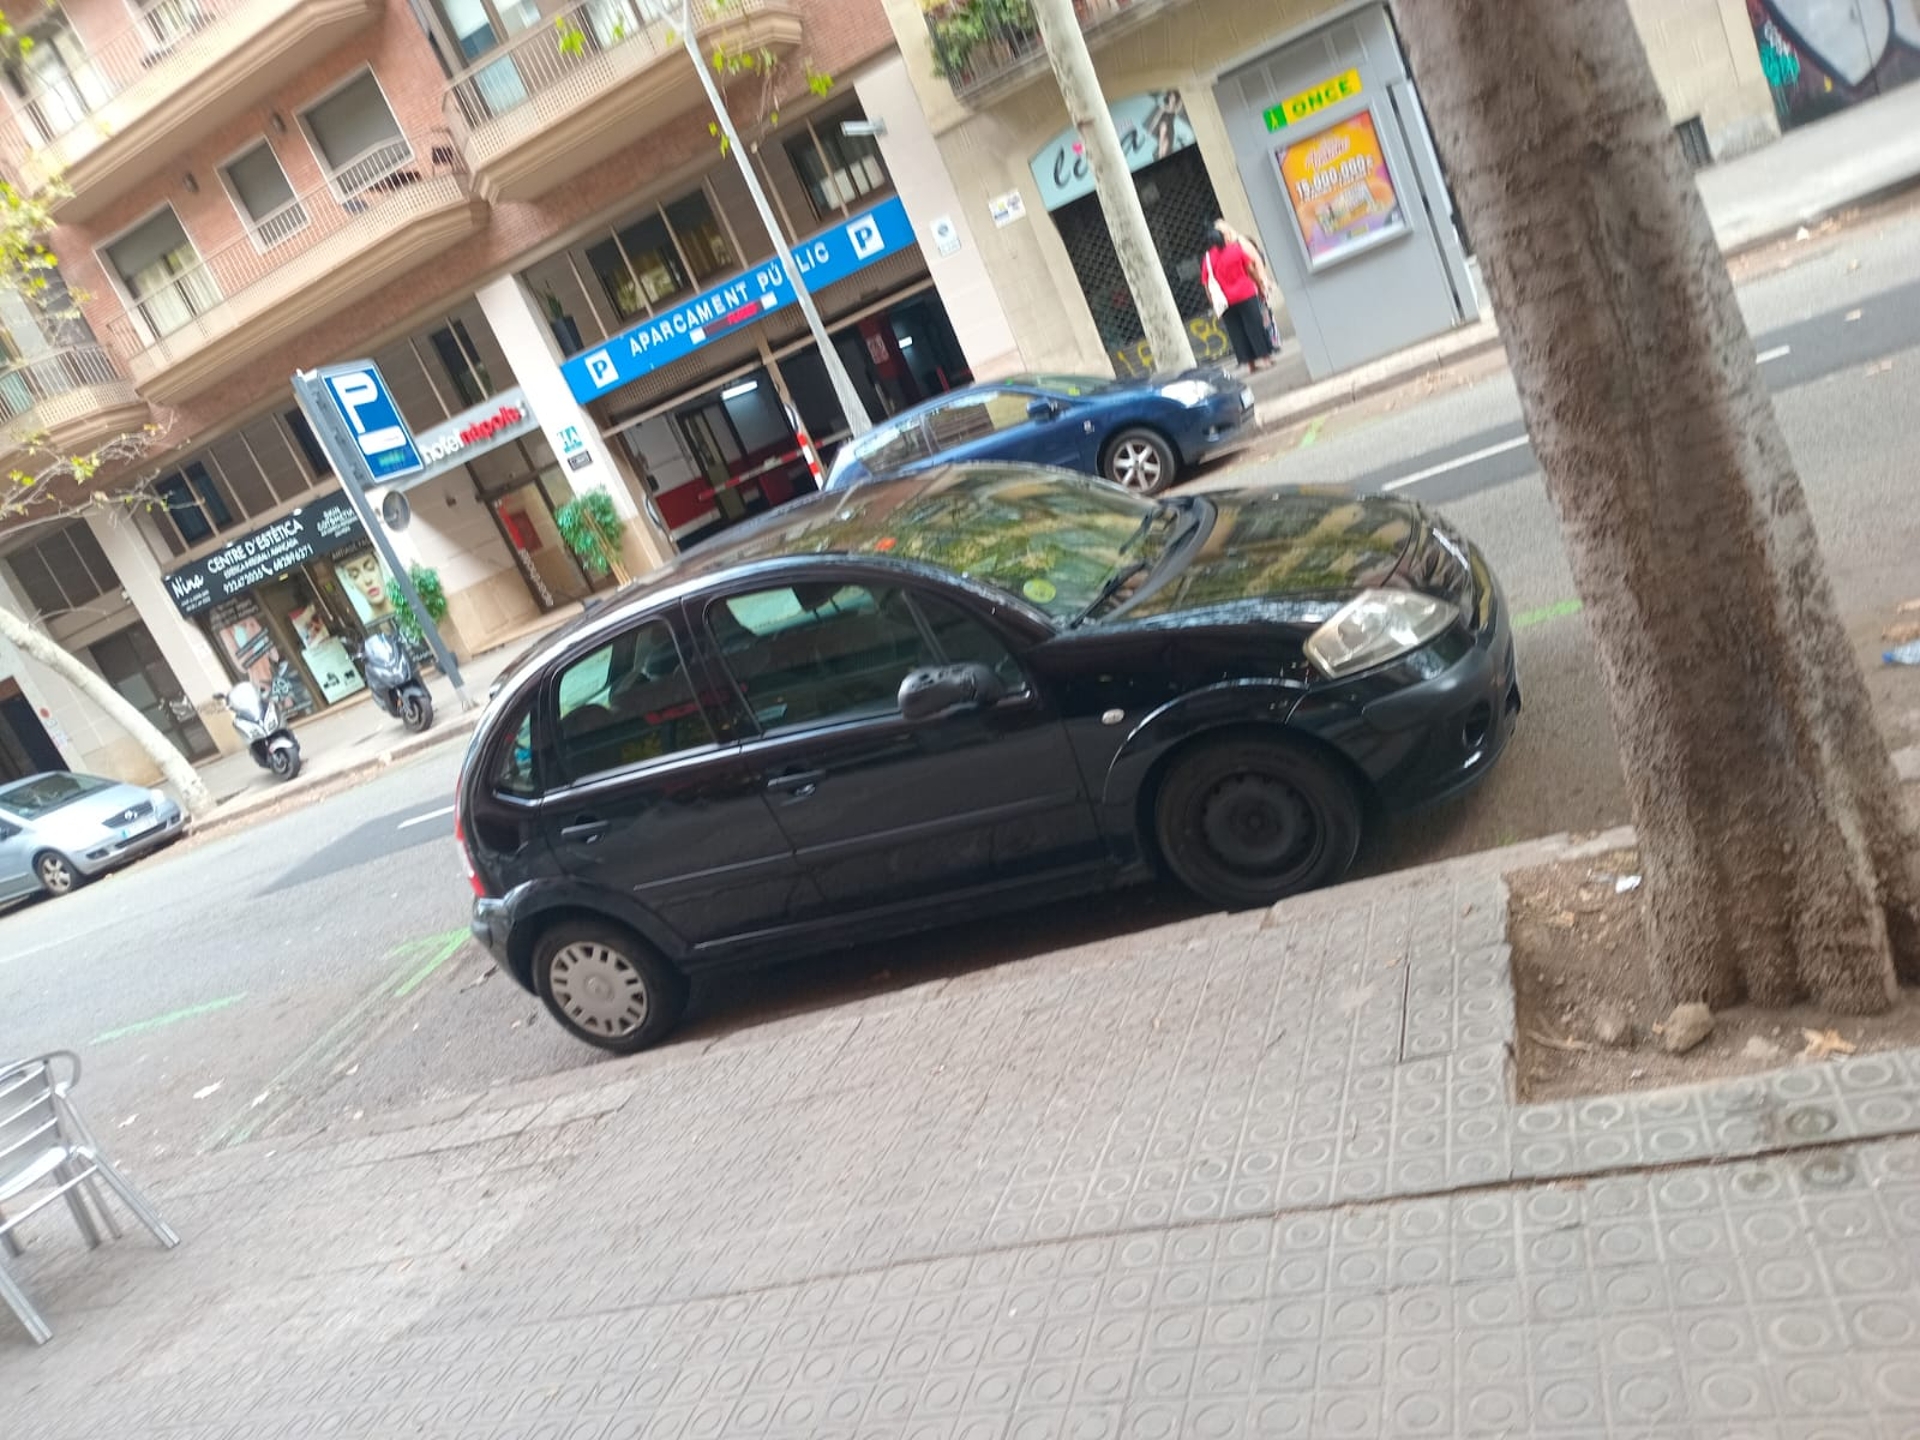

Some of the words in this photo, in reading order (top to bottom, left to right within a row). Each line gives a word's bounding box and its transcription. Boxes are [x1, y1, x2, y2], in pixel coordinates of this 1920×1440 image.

[1292, 79, 1353, 117] ONCE
[629, 282, 749, 357] APARCAMENT
[755, 242, 829, 293] PÚLIC
[331, 371, 379, 434] P
[207, 545, 247, 574] CENTRE
[246, 518, 304, 556] D'ESTÈTICA
[171, 574, 204, 598] Nina
